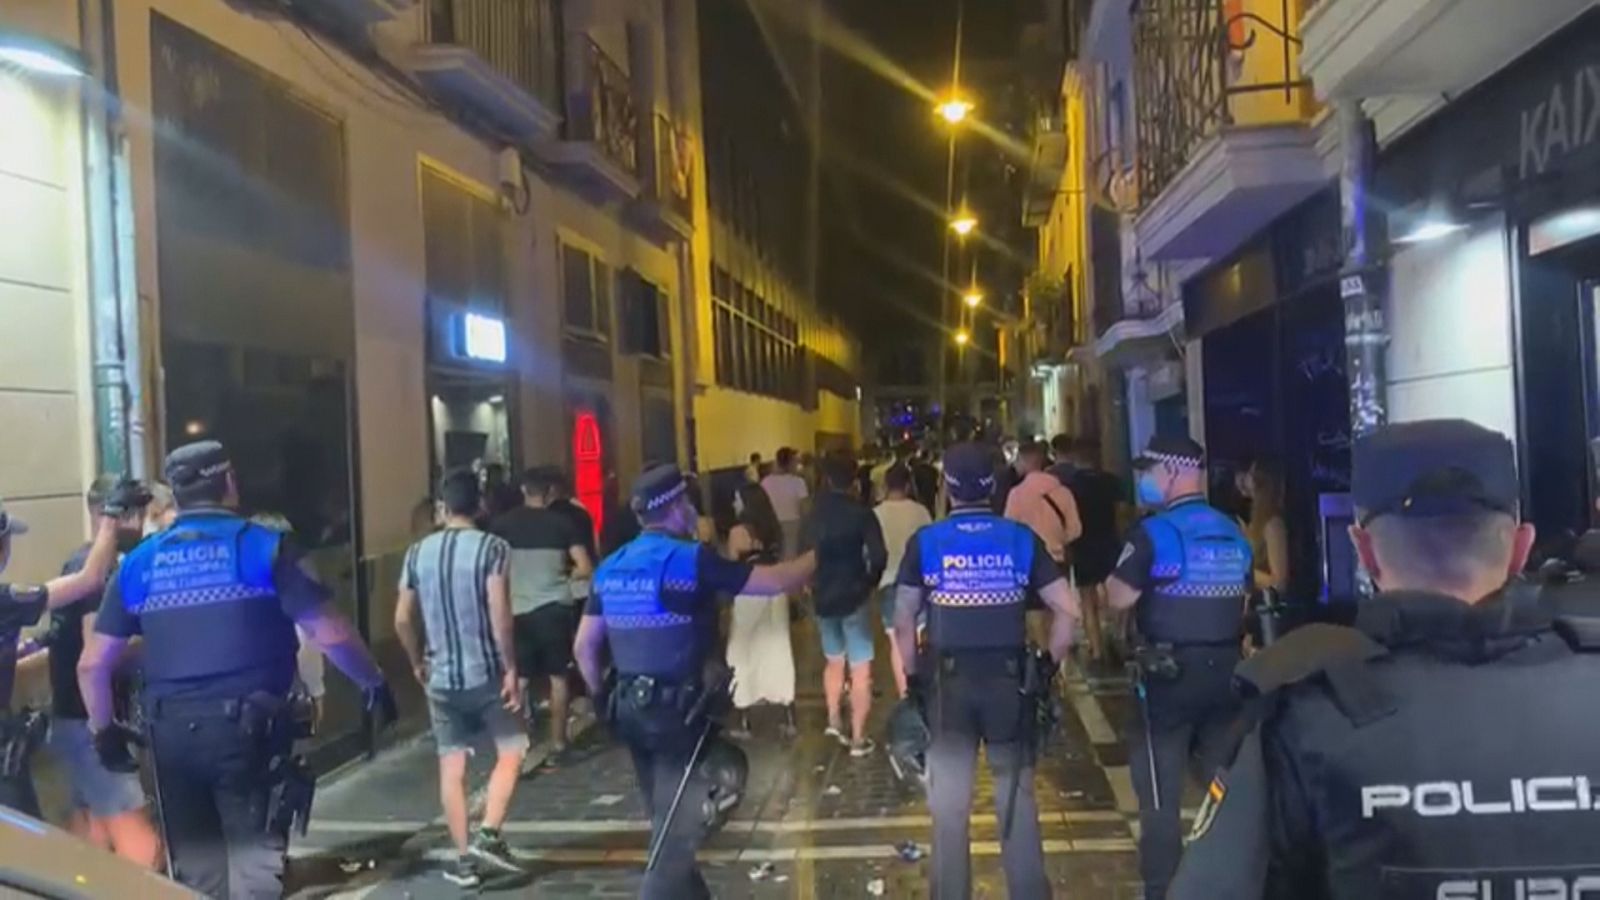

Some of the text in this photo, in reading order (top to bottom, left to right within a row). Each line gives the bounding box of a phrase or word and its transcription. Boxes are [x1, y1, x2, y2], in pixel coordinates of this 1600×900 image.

[154, 544, 230, 568] POLICIA
[942, 554, 1014, 569] POLICIA
[1361, 776, 1600, 818] POLICI
